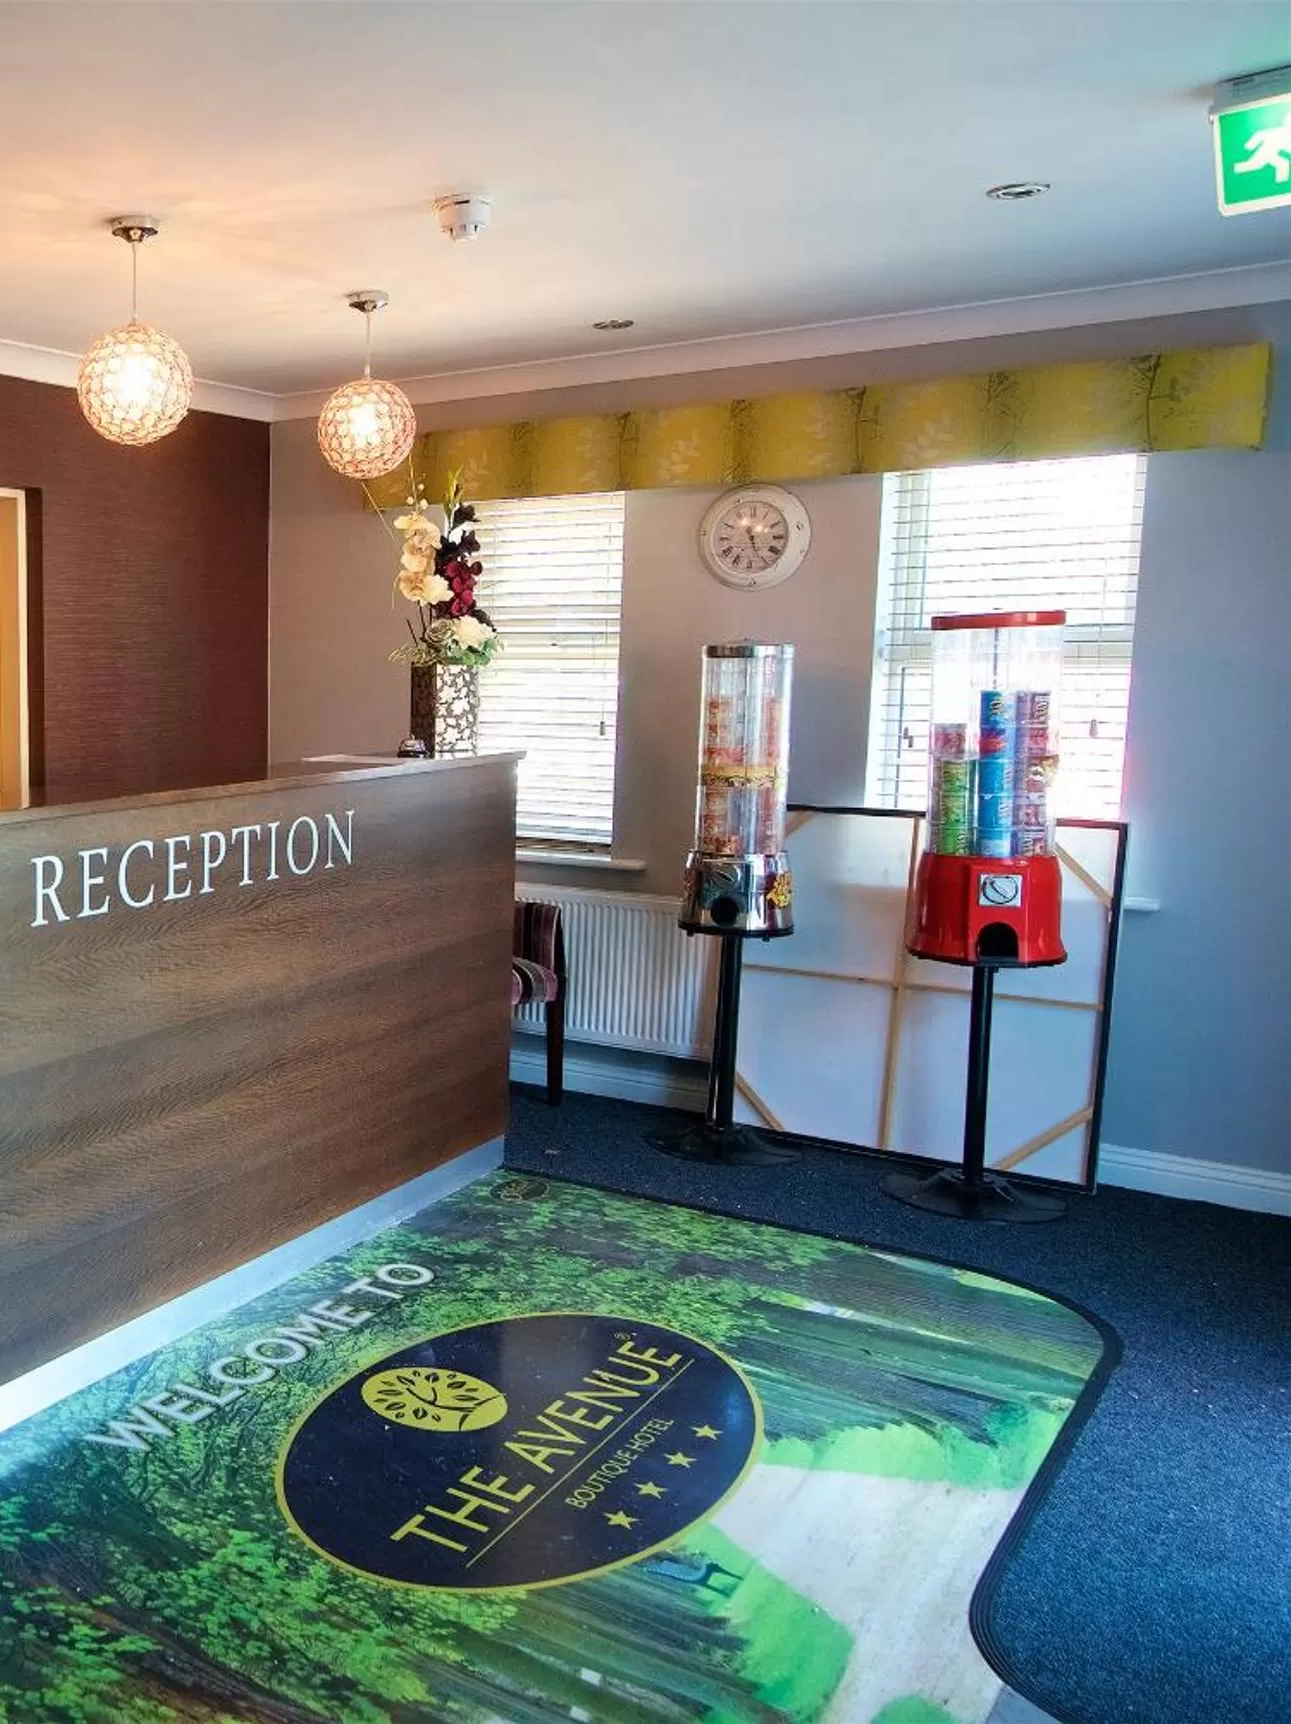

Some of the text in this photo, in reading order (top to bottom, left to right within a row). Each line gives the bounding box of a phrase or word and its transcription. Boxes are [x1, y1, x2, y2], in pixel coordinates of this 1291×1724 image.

[30, 809, 356, 928] RECEPTION
[83, 1263, 435, 1452] WELCOME TO
[390, 1340, 683, 1553] THE AVENUE
[564, 1418, 675, 1509] BOUTIQUE HOTEL
